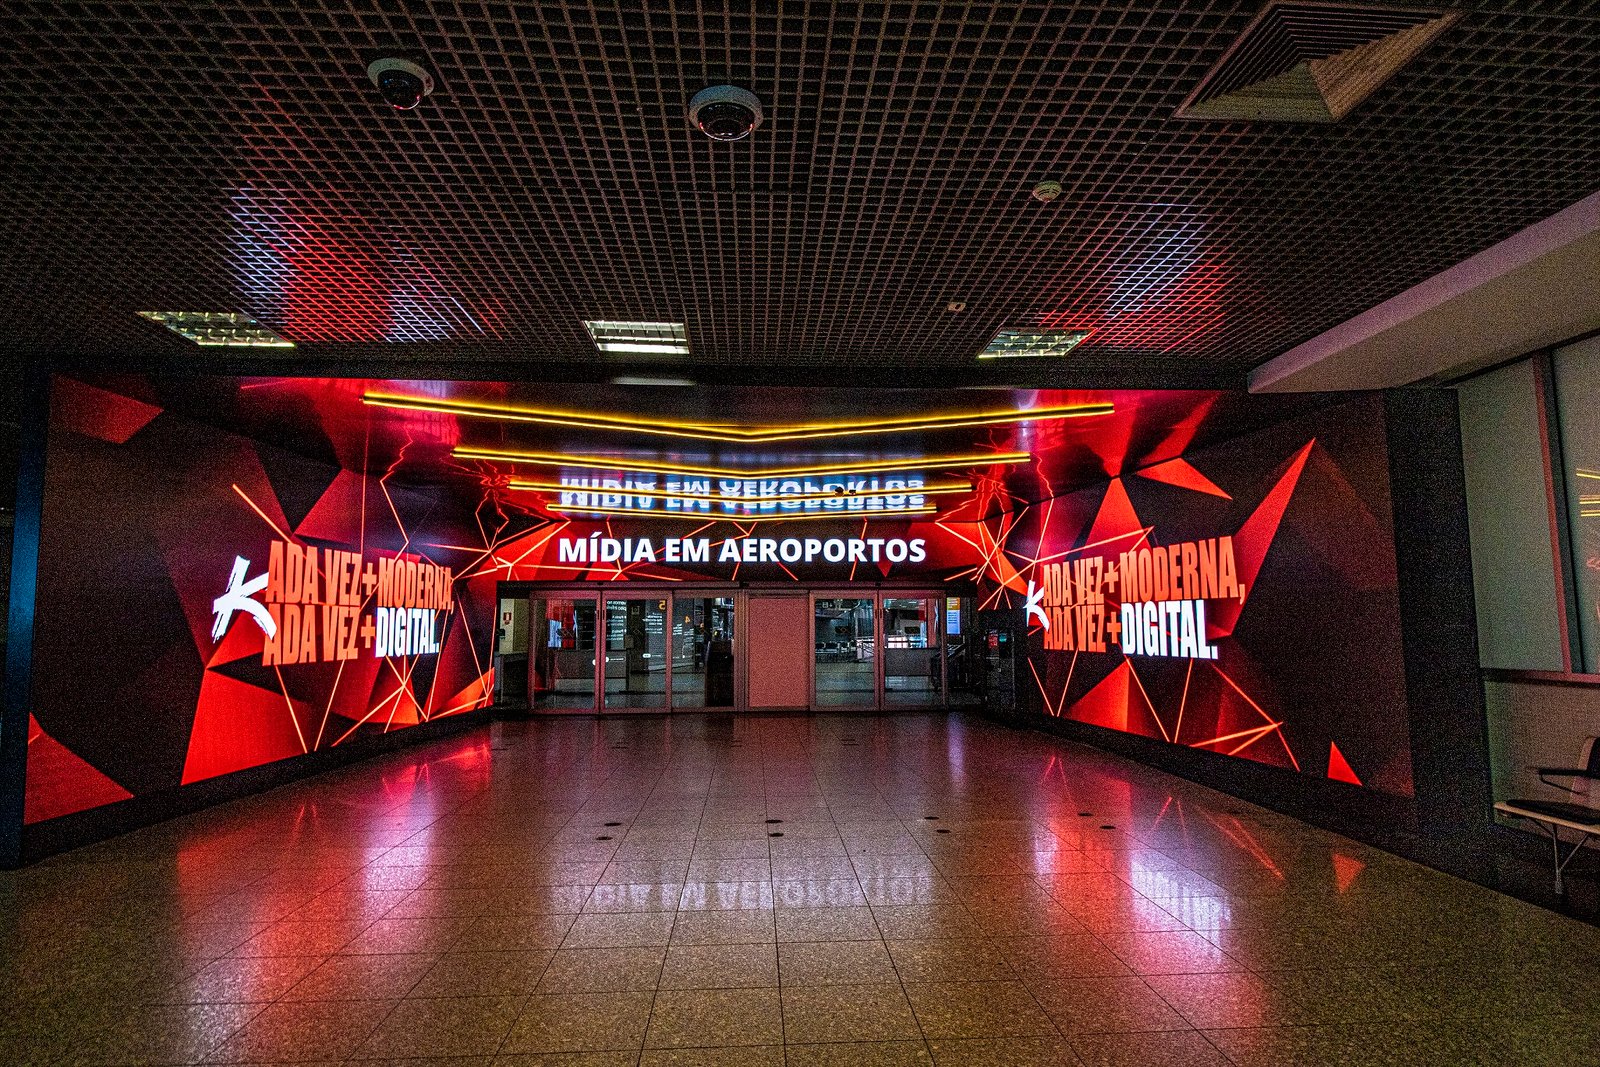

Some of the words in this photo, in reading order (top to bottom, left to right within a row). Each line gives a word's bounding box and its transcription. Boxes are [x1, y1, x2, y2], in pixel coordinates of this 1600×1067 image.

[559, 531, 656, 563] MÍDIA
[665, 538, 710, 563] EM
[718, 538, 926, 563] AEROPORTOS
